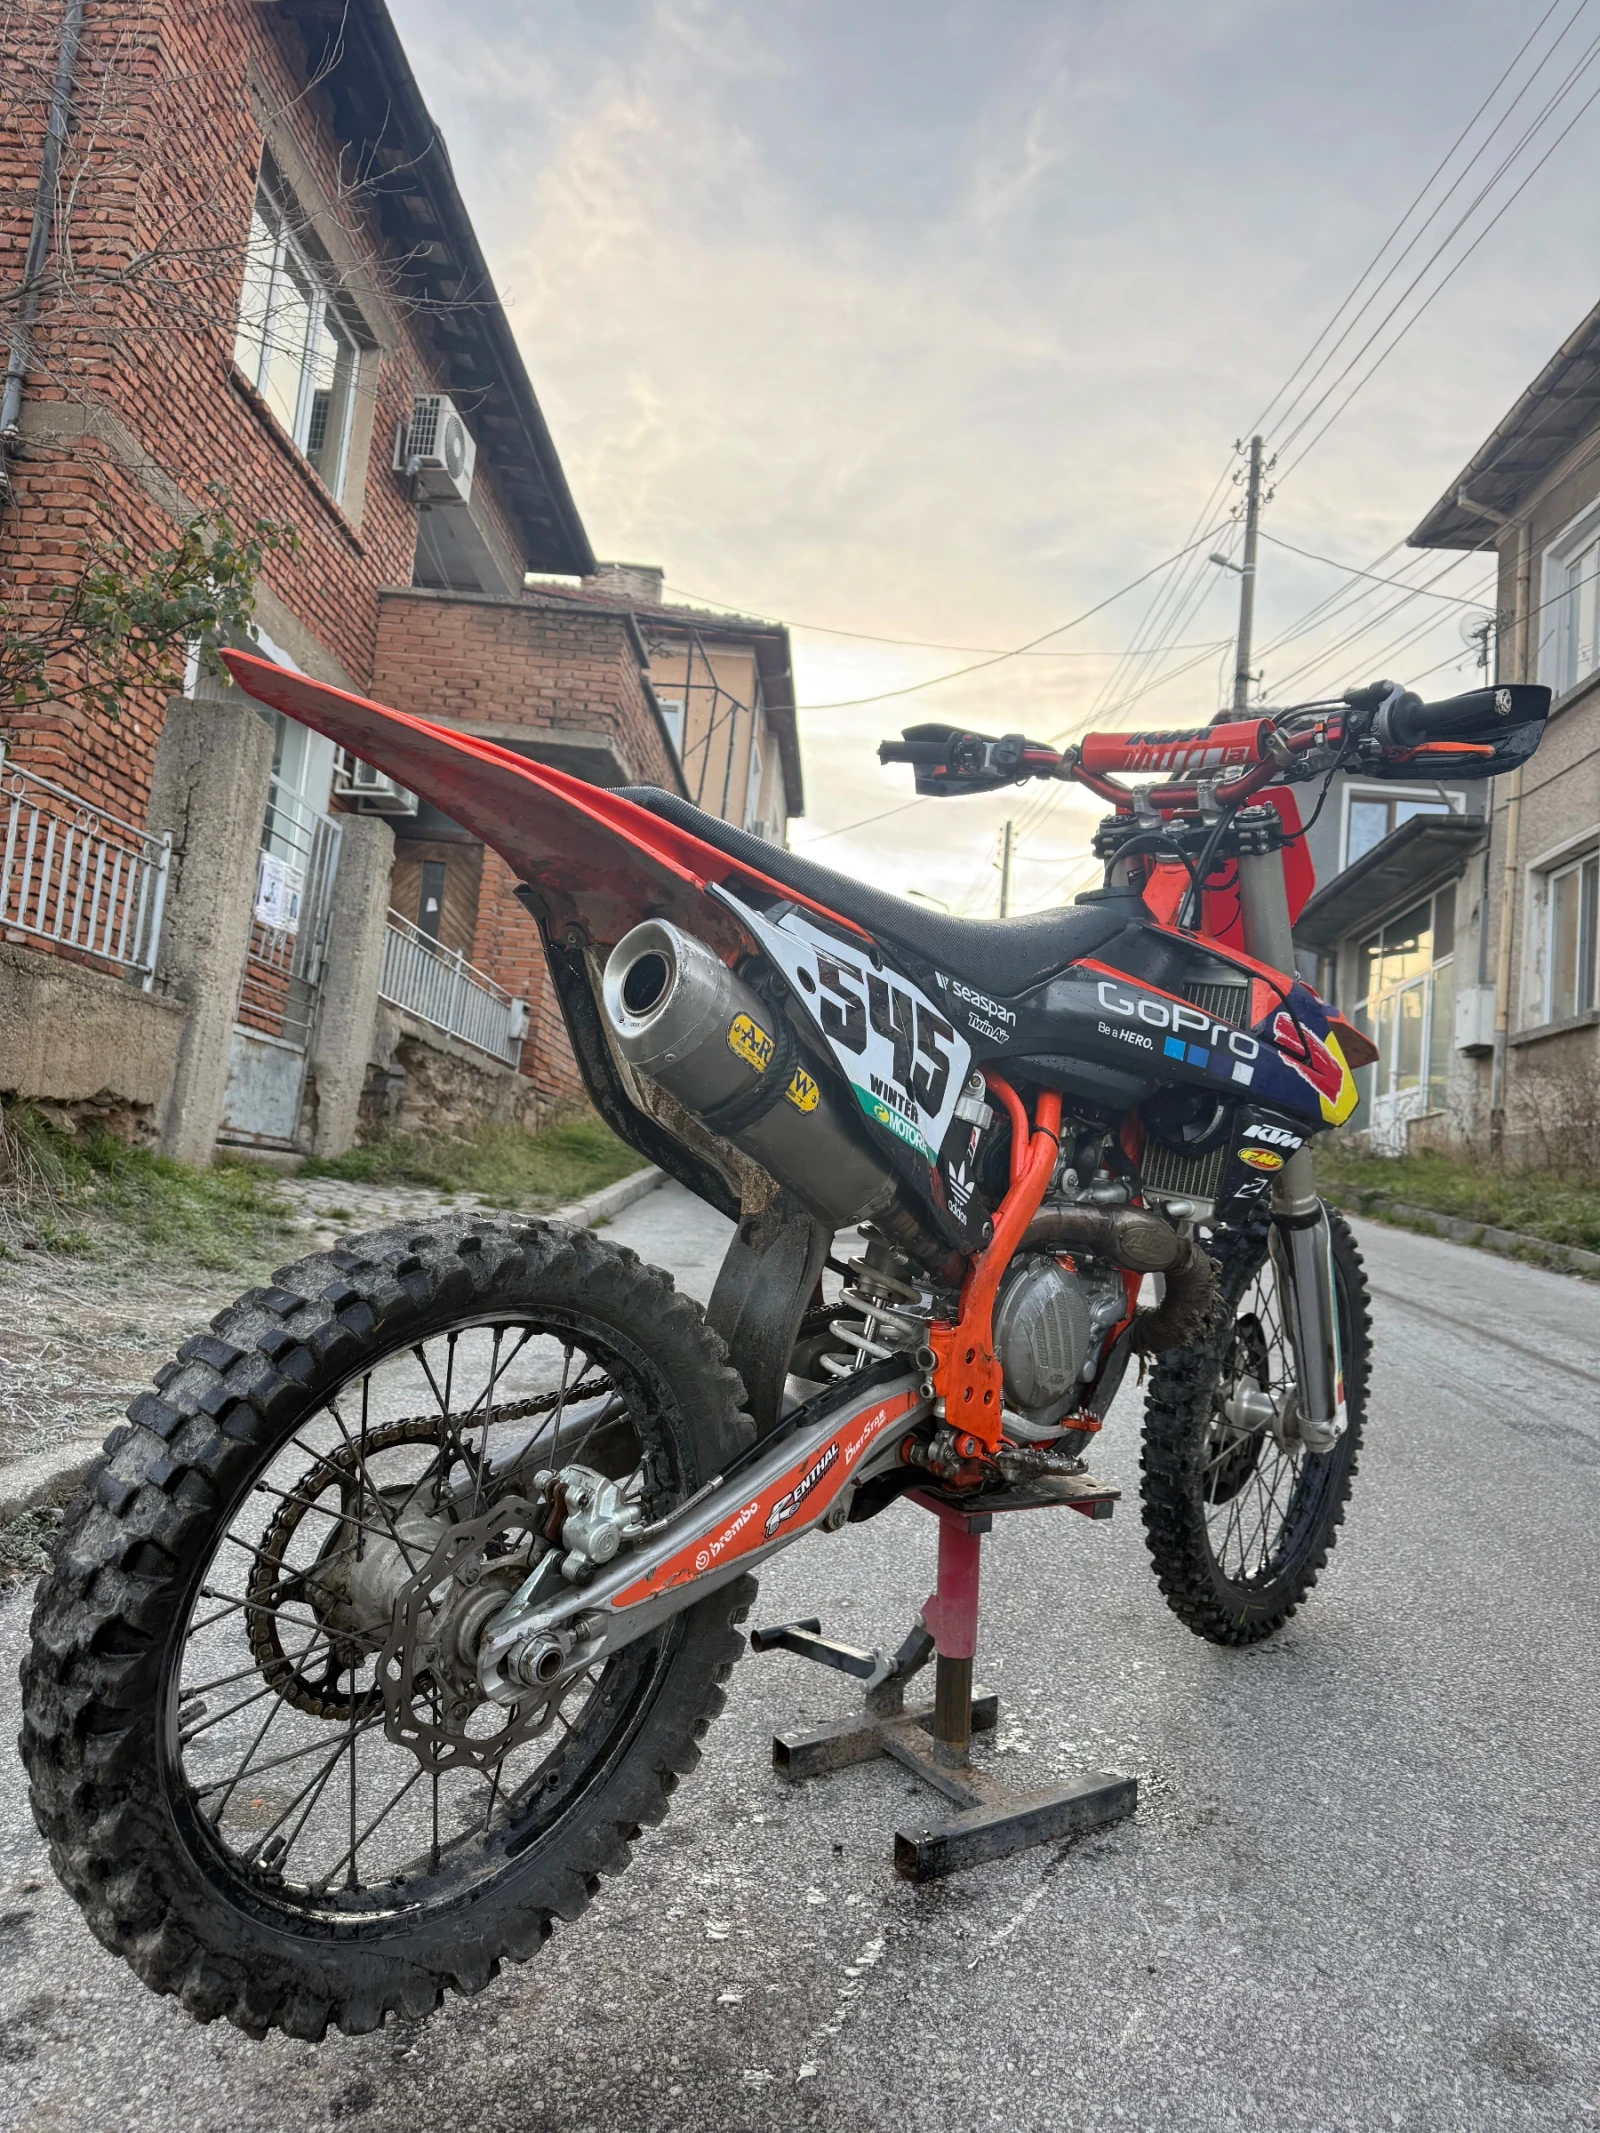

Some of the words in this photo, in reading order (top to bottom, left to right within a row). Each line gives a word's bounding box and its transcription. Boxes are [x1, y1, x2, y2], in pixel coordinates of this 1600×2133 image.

[952, 980, 1017, 1028] seaspan
[1097, 981, 1260, 1060] GoPro
[811, 942, 955, 1119] 545
[1097, 1021, 1111, 1035] Be
[1112, 1029, 1119, 1038] a
[1118, 1028, 1154, 1051] HERO.
[869, 1072, 919, 1126] WINTER
[1242, 1124, 1303, 1150] KTM
[947, 1195, 968, 1226] adidas
[711, 1502, 760, 1558] brembo
